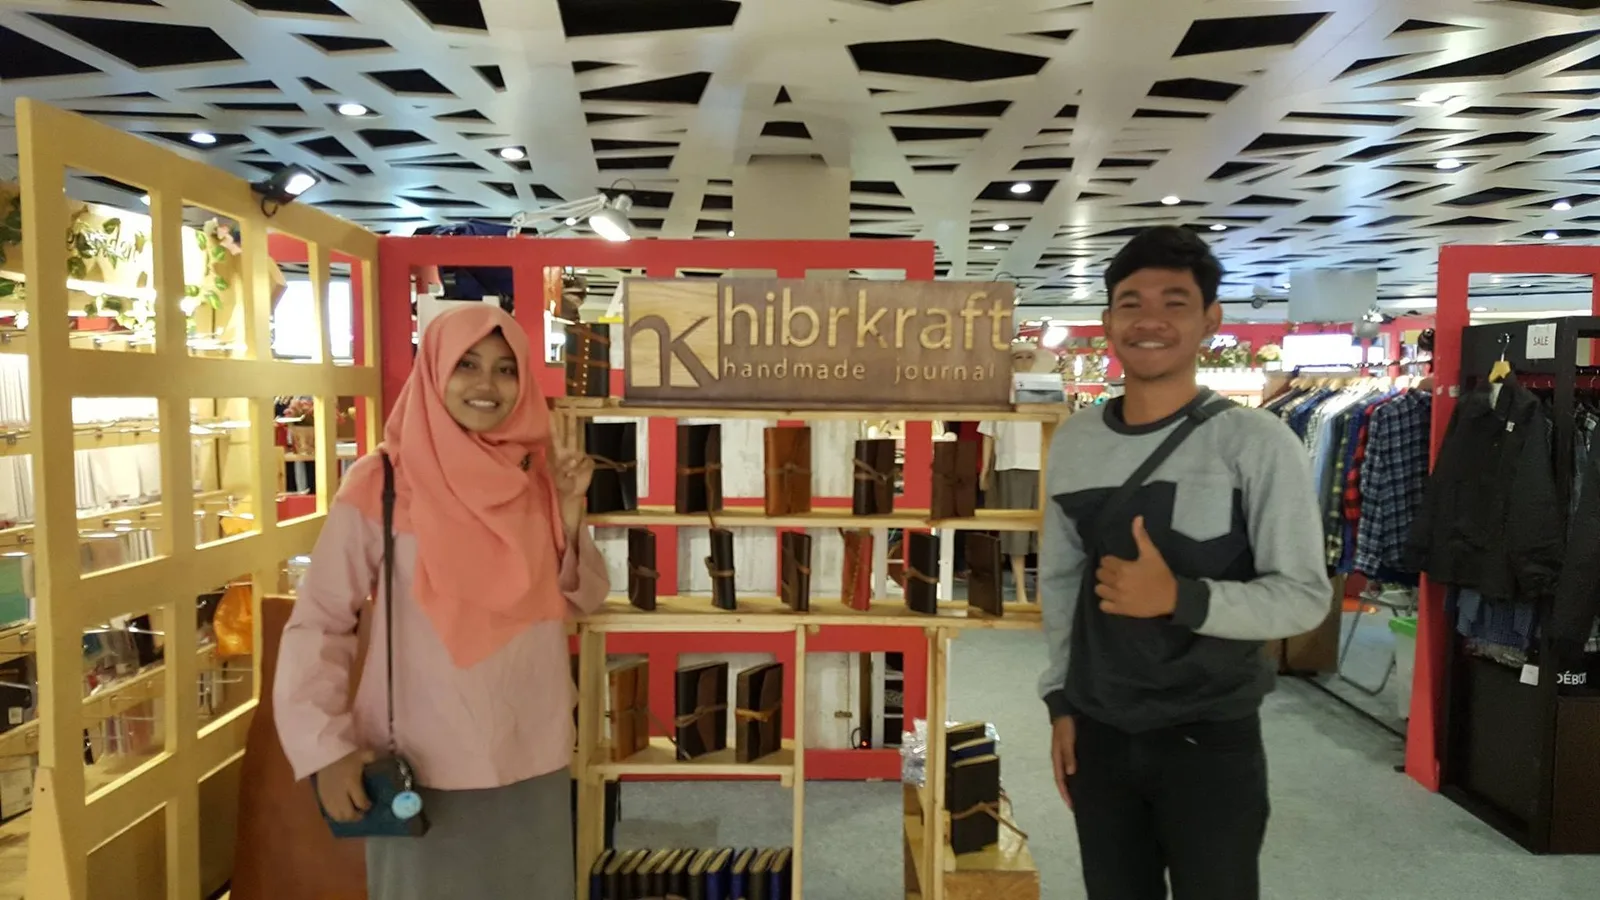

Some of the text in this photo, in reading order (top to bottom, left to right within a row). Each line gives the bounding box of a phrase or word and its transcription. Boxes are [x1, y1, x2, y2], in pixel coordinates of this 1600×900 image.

[723, 286, 1011, 350] hibrkraft
[1533, 336, 1549, 346] SALE
[723, 357, 996, 384] handmade journal
